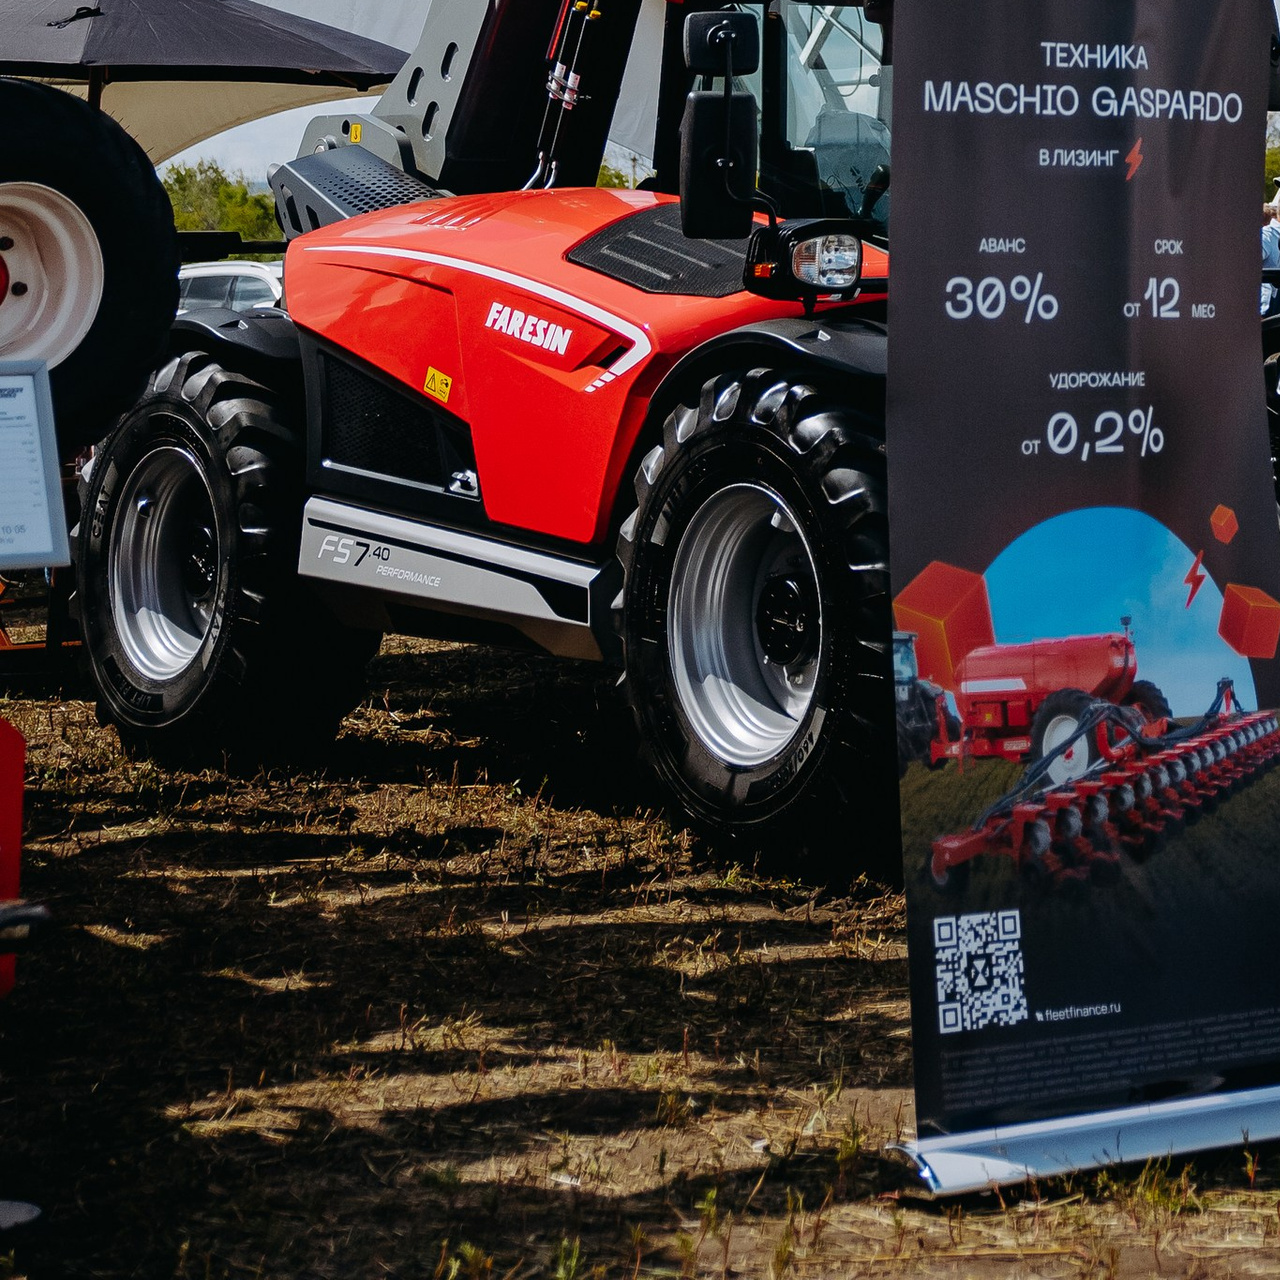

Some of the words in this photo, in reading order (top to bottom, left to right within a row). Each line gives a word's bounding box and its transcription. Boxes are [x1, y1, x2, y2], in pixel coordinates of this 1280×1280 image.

[1040, 41, 1149, 70] ТЕХНИКА
[923, 80, 1080, 117] MASCHIO
[1091, 85, 1244, 123] GASPARDO
[1052, 149, 1120, 167] ЛИЗИНГ
[978, 237, 1026, 253] АВАНС
[1154, 239, 1183, 255] СРОК
[945, 271, 1059, 324] 30%
[1143, 277, 1180, 318] 12
[485, 301, 573, 356] FARESIN
[1049, 371, 1146, 389] УДОРОЖАНИЕ
[1046, 403, 1165, 462] 0,2%
[375, 564, 442, 587] PERFORMANCE
[1045, 1001, 1122, 1021] fleetfinance.ru
